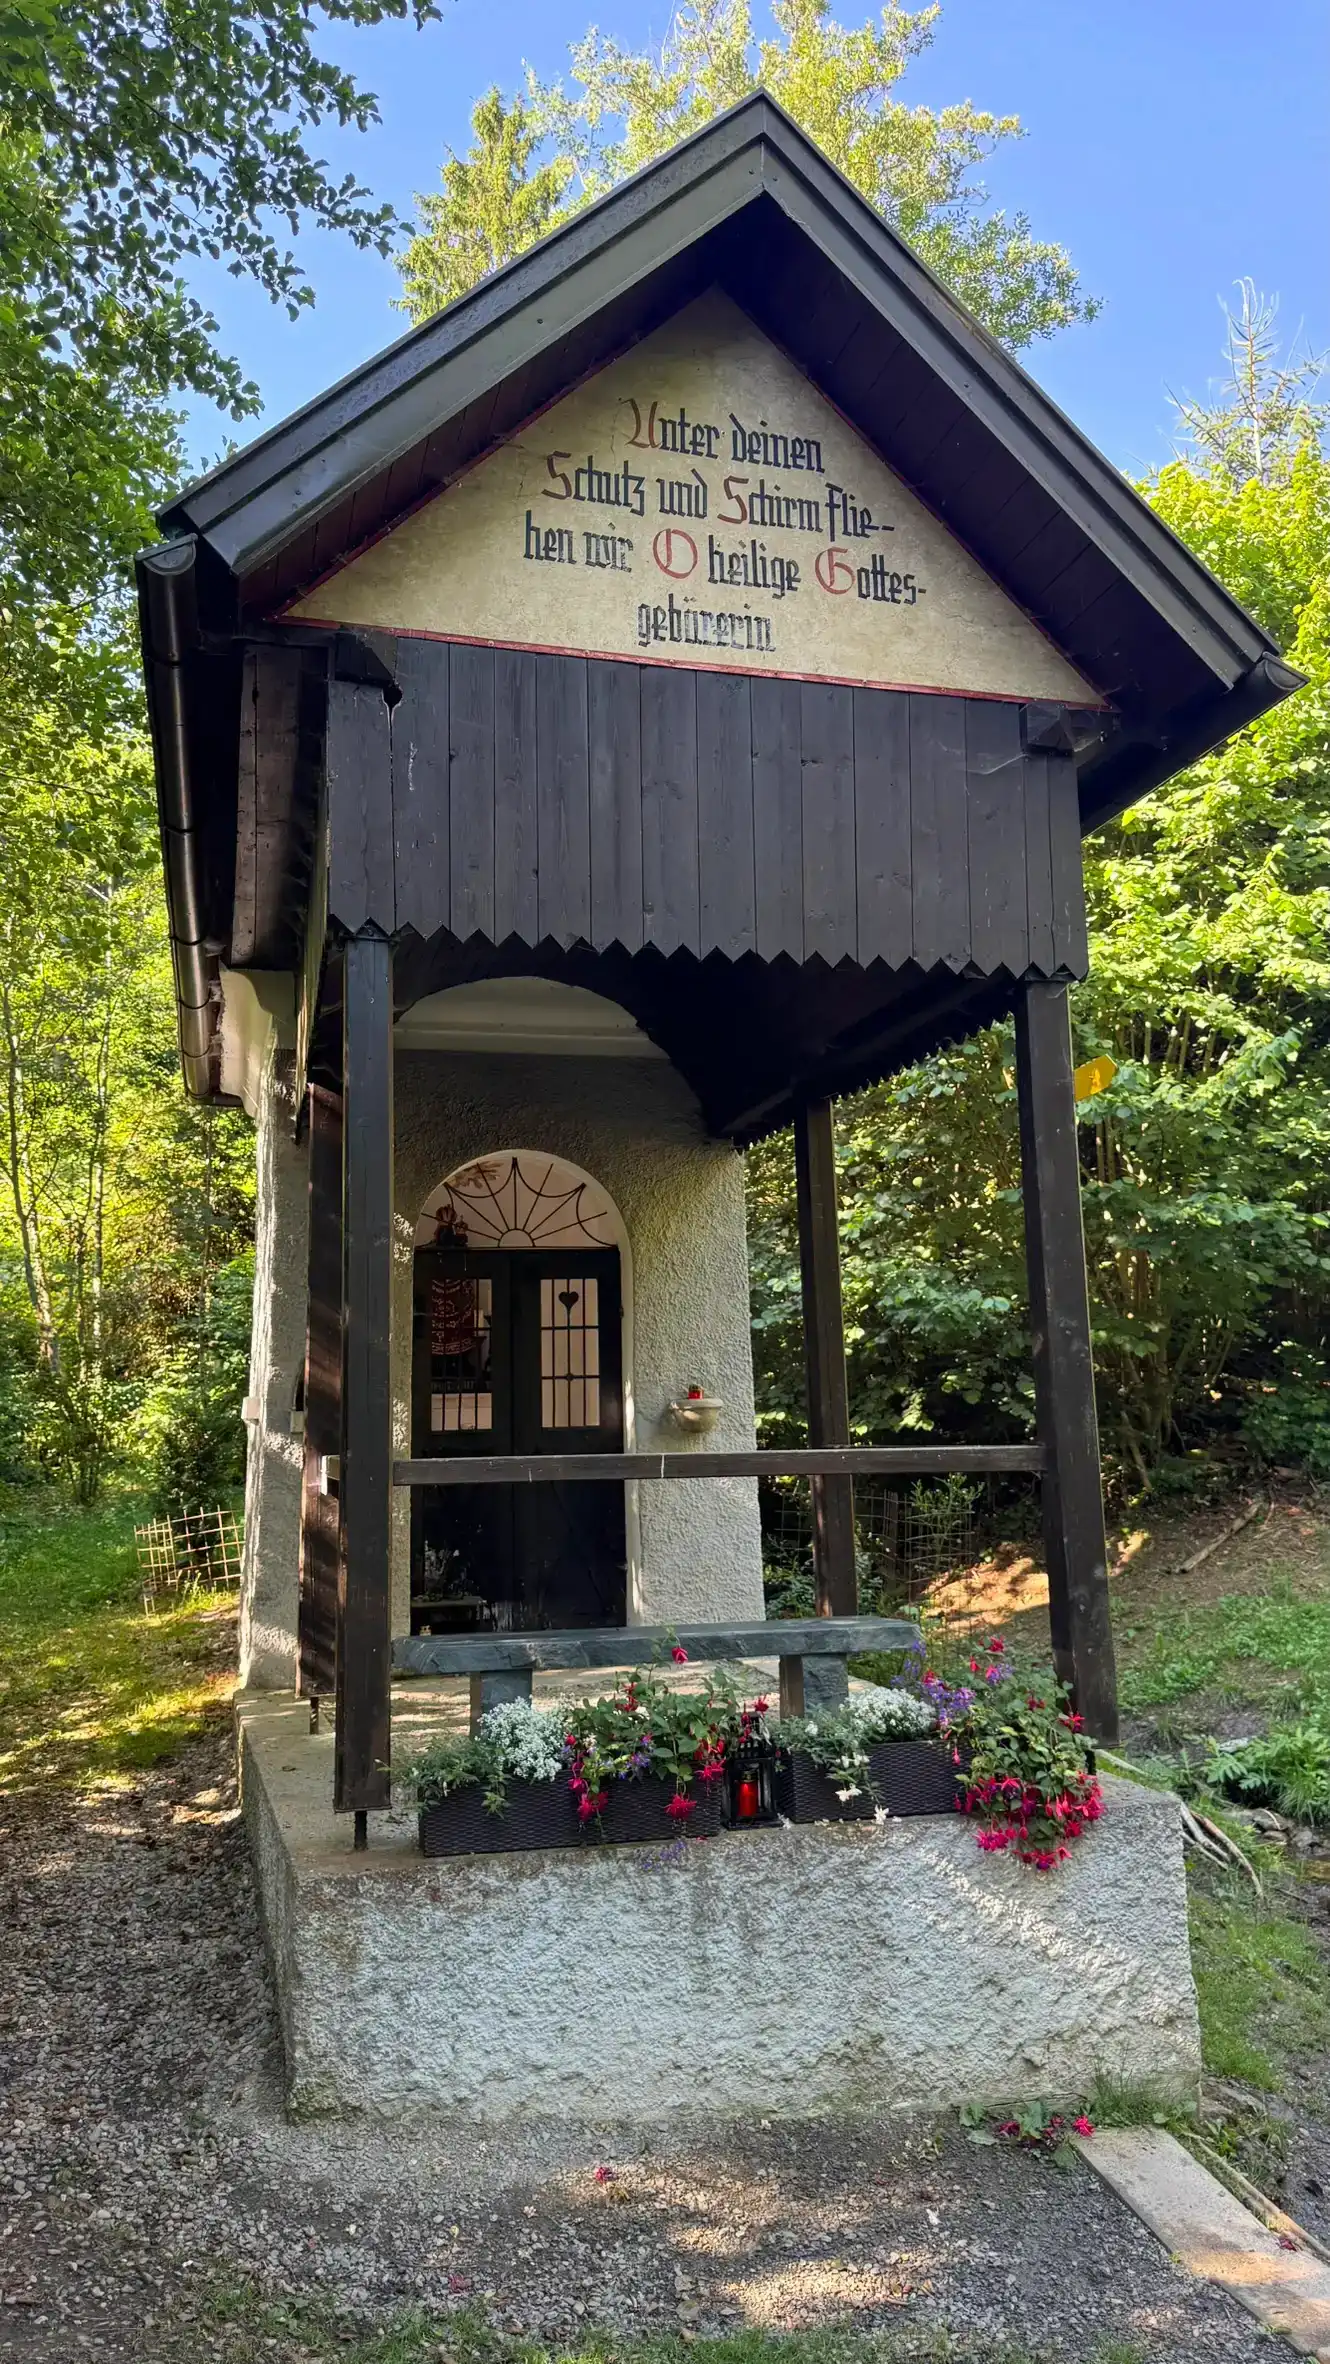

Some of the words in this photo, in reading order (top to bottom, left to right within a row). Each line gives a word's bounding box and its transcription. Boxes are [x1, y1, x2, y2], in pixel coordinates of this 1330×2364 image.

[617, 397, 719, 459] Unter
[729, 413, 826, 474] deinen
[541, 450, 645, 516] Schutz
[655, 468, 708, 519] und
[717, 475, 824, 533] Schirm
[523, 510, 577, 565] hen
[583, 522, 634, 573] wir
[652, 528, 698, 580] O
[707, 534, 801, 599] heilige
